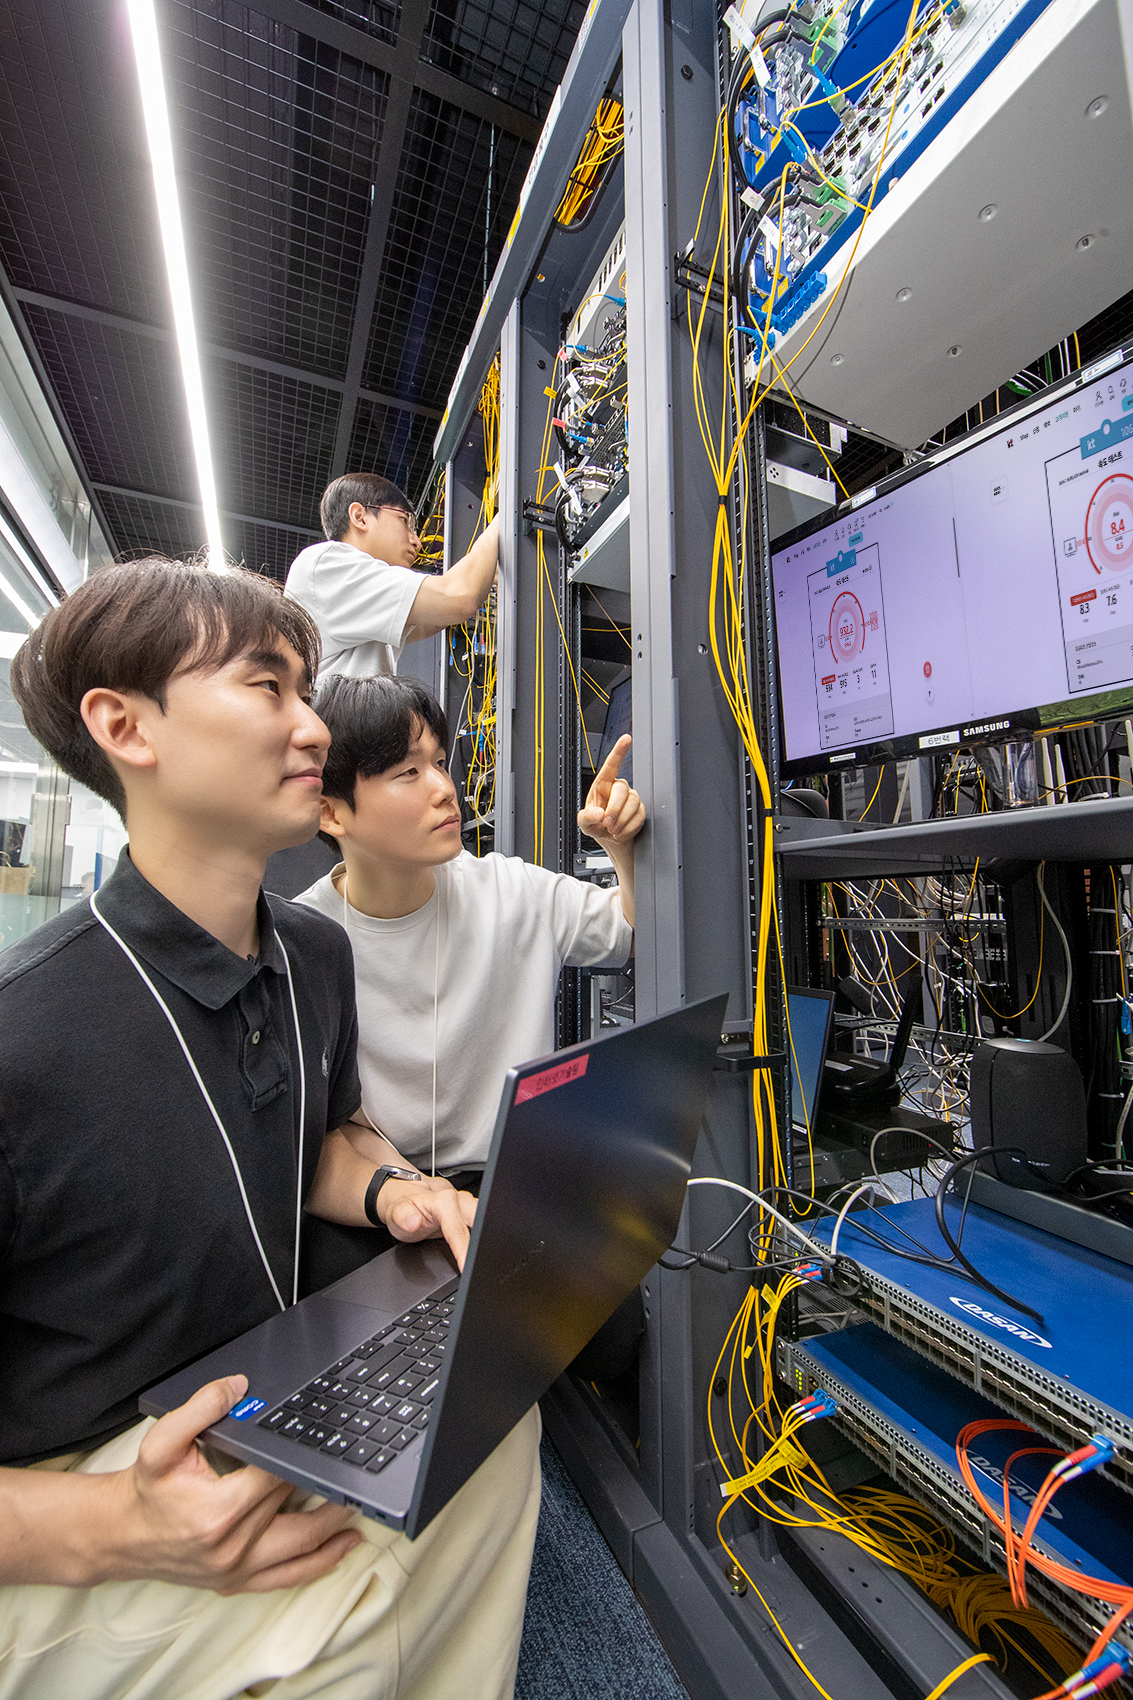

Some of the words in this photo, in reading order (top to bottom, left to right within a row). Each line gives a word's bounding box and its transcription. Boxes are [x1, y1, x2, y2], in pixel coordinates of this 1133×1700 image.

[1110, 518, 1125, 535] 8.4
[963, 720, 1010, 737] SAMSUNG
[962, 1303, 1037, 1341] DASAN
